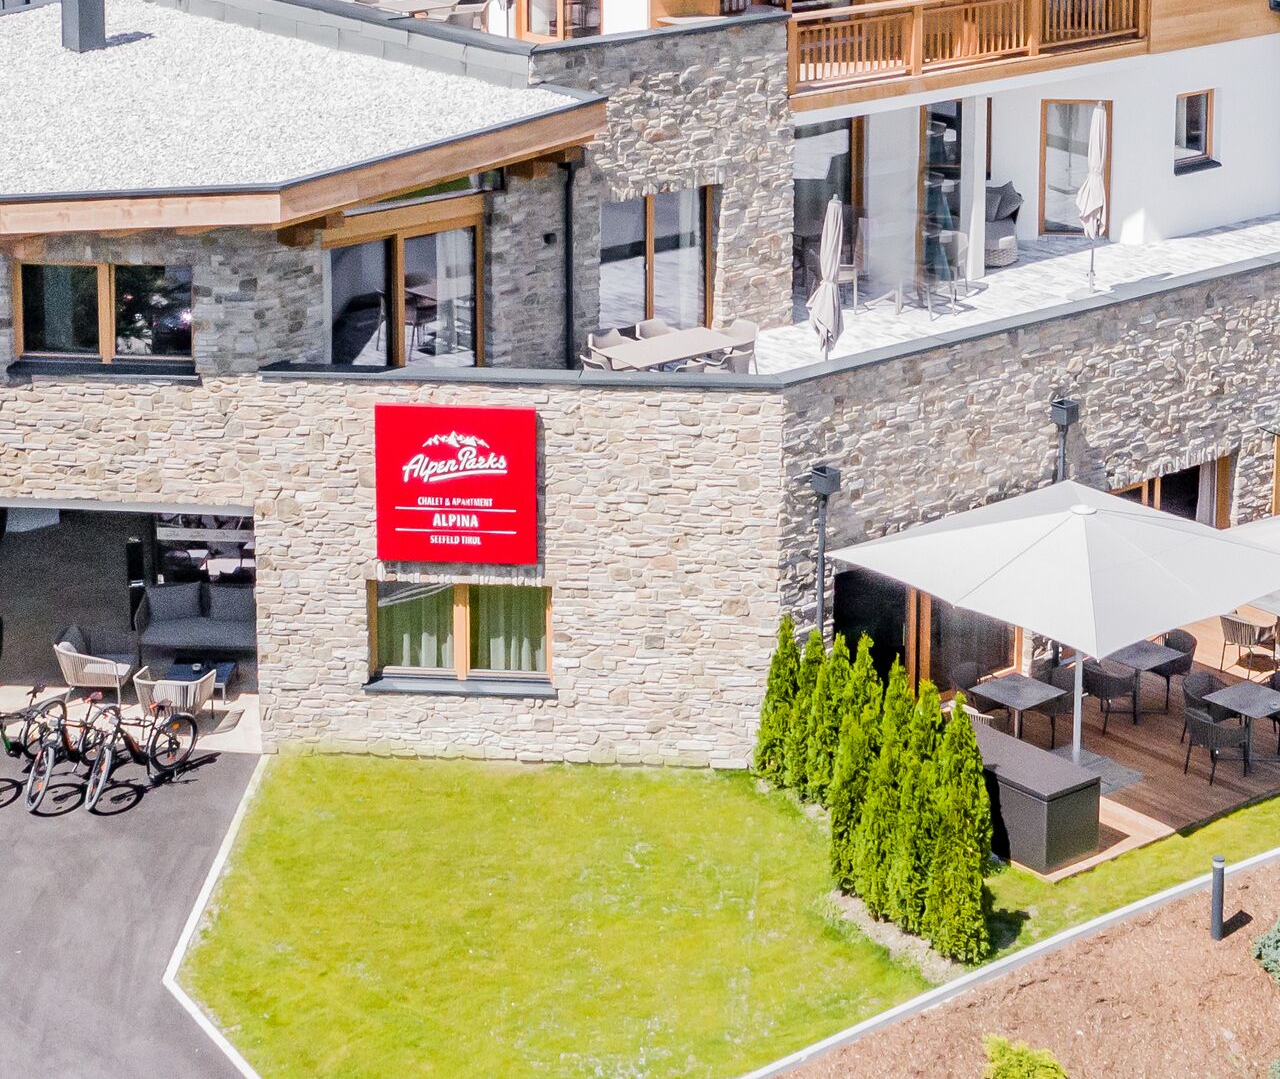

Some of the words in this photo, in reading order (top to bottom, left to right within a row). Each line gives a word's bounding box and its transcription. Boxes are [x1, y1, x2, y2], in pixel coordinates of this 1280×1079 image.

[417, 496, 443, 506] CHALET
[444, 497, 451, 506] &
[451, 497, 493, 507] APARTMENT
[432, 513, 479, 528] ALPINA
[430, 535, 460, 545] SEEFELD
[461, 535, 482, 546] TIROL
